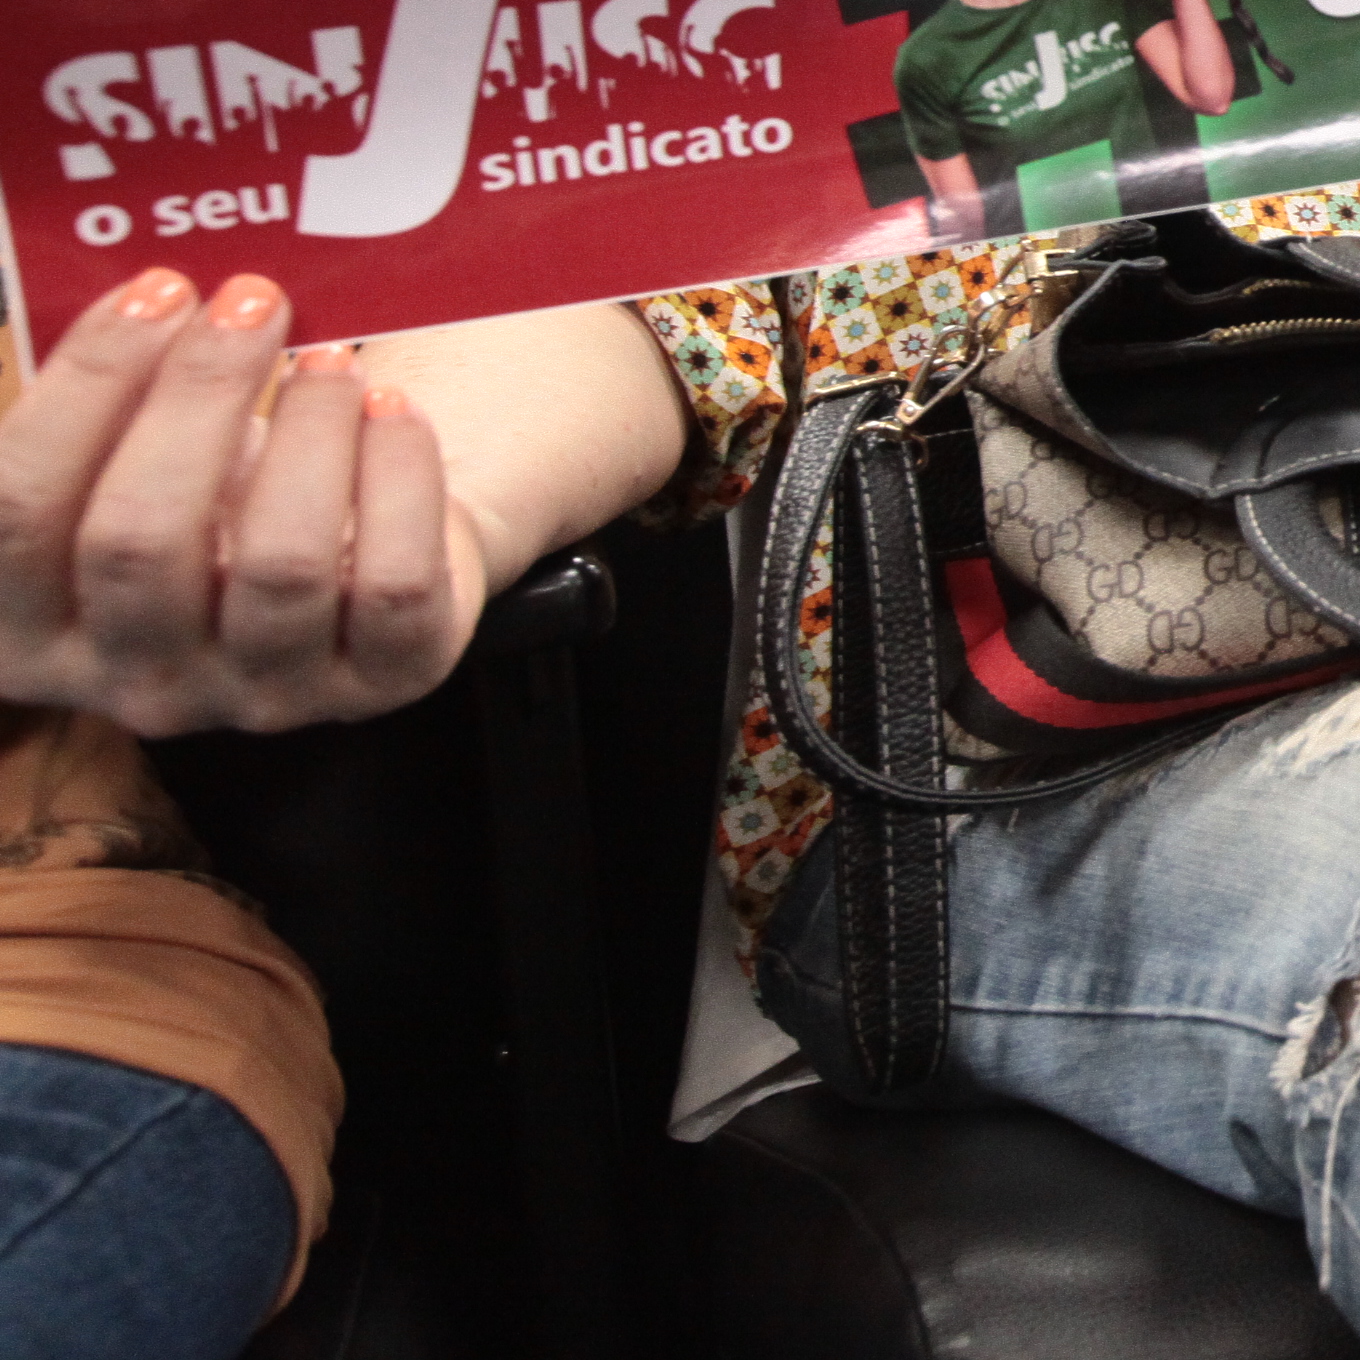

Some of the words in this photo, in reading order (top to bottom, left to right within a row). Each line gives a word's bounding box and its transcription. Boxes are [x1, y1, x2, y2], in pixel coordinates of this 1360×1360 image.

[74, 202, 132, 246] o
[153, 182, 290, 237] seu
[479, 115, 794, 192] sindicato
